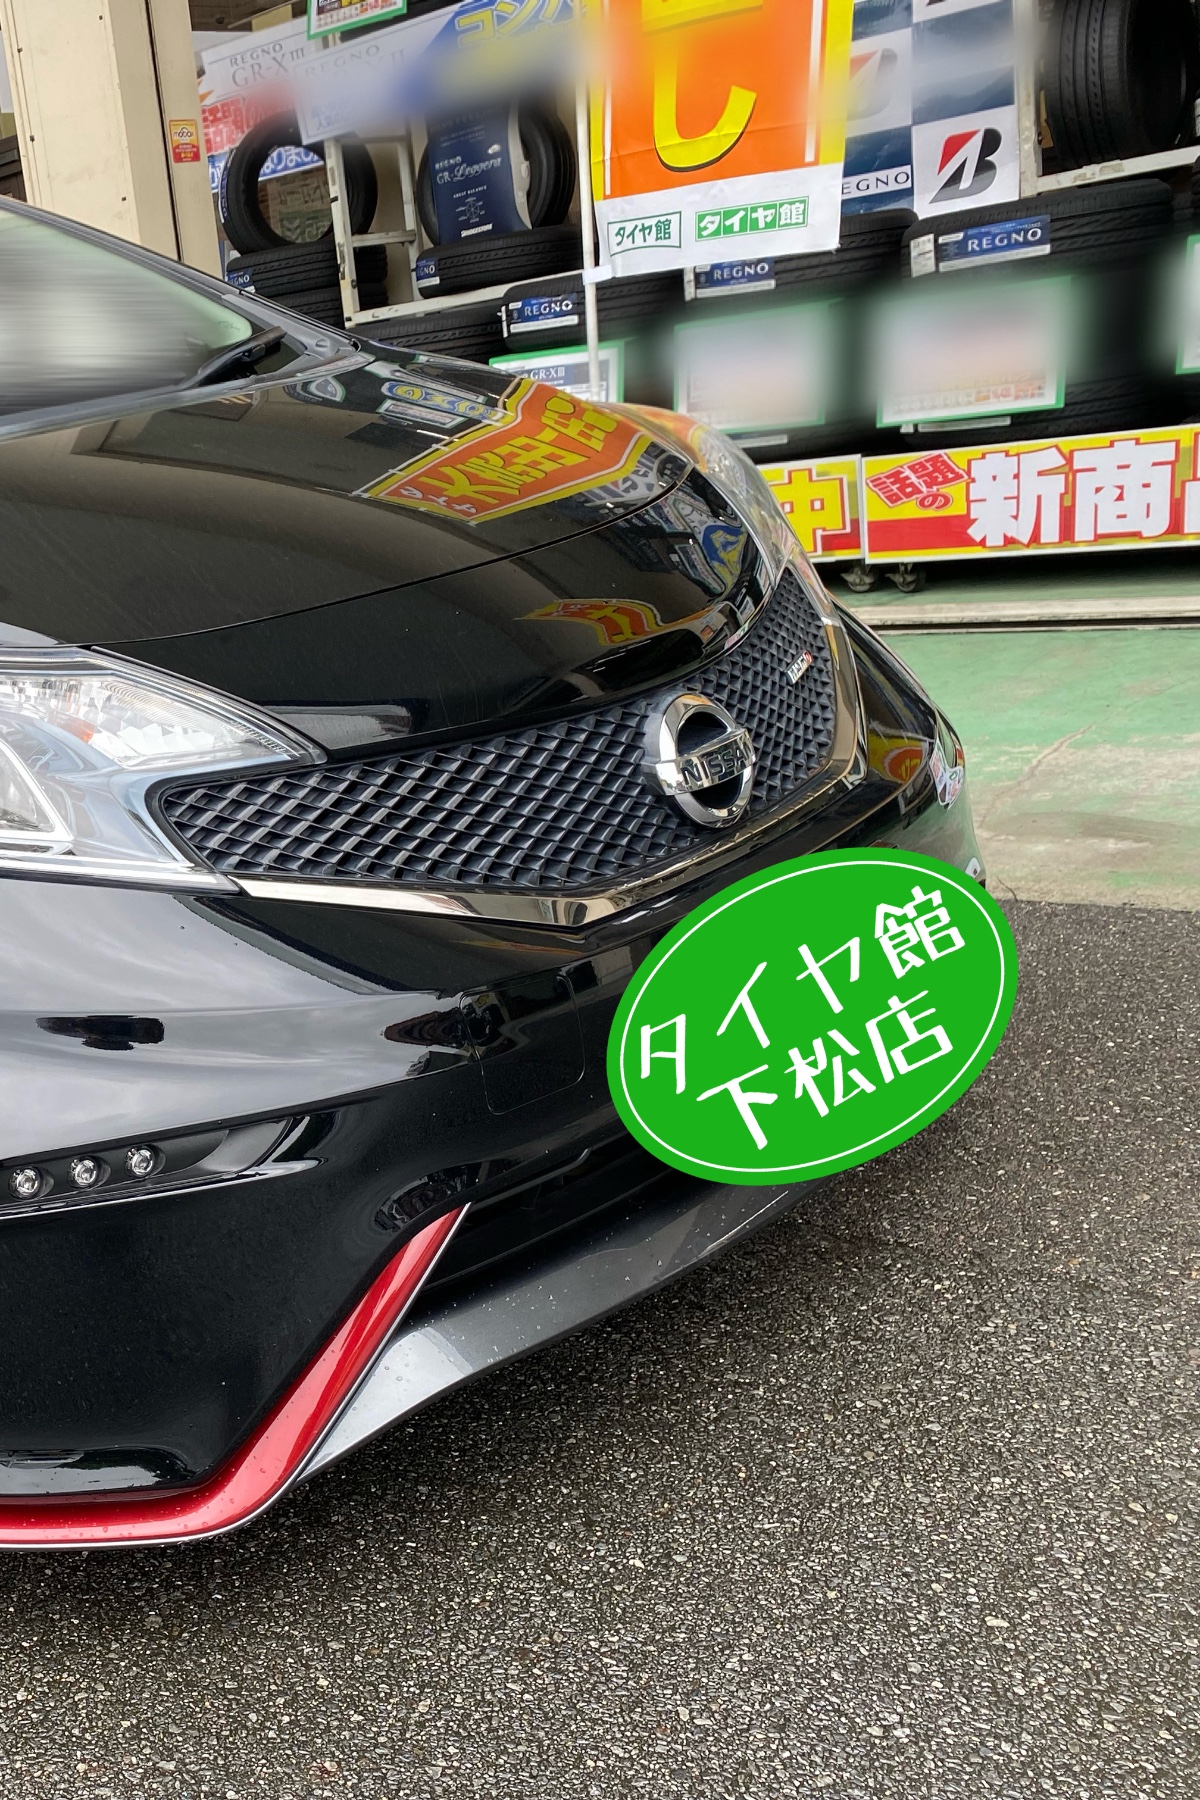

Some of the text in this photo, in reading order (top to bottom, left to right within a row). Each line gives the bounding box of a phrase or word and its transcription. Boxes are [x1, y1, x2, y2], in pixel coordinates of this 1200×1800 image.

[229, 43, 283, 68] REGNO
[614, 202, 805, 247] タイヤ館 タイヤ館
[967, 227, 1042, 252] REGNO
[713, 262, 769, 281] REGNO
[524, 300, 573, 316] REGNO
[866, 451, 970, 511] 話題の
[966, 431, 1200, 548] 新商
[680, 734, 754, 788] NISSAN
